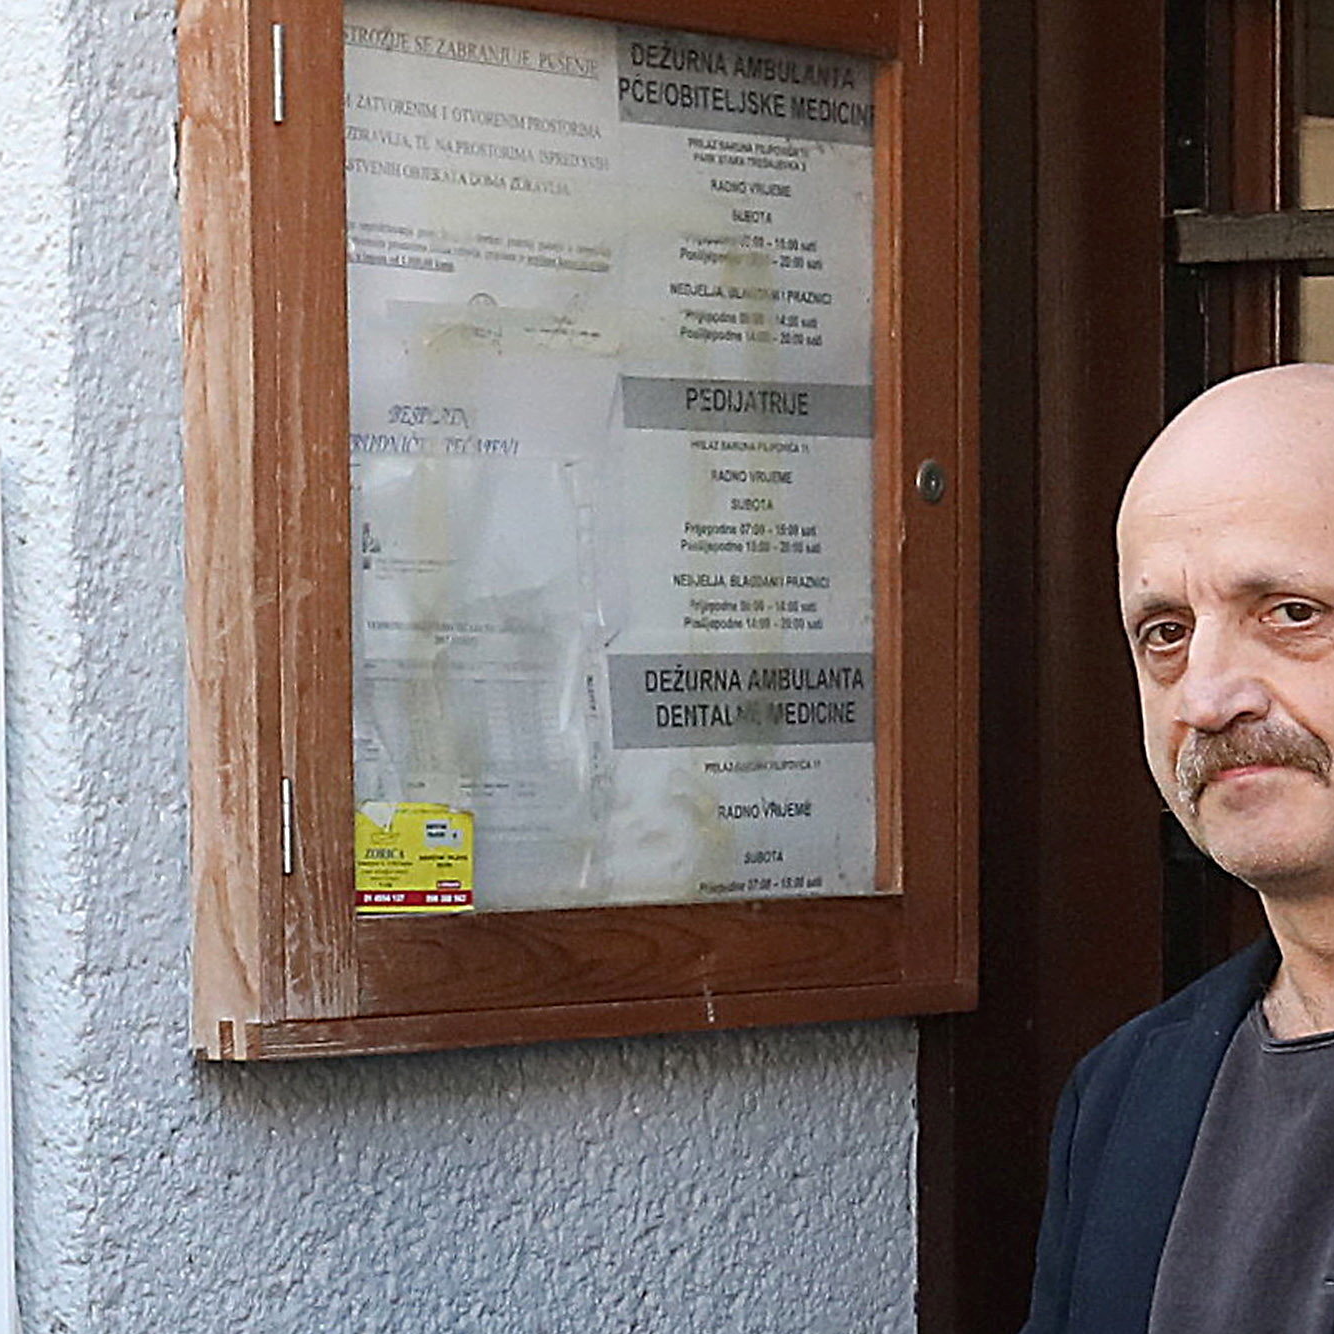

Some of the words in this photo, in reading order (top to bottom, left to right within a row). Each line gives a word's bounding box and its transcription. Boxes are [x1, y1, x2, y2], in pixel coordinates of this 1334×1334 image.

[415, 37, 432, 51] SE
[437, 38, 532, 67] ZABRANJUJE
[538, 51, 599, 75] PUŠENJE
[630, 42, 728, 77] DEŽURNA
[734, 54, 856, 90] AMBULANTA
[357, 95, 438, 121] ZATVORENIM
[711, 179, 747, 195] RADNO
[685, 387, 810, 416] PEDIJATRIJE
[711, 469, 747, 483] RADNO
[749, 470, 793, 485] VRIJEME
[730, 498, 774, 512] SUBOTA
[644, 664, 743, 693] DEŽURNA
[747, 667, 865, 693] AMBULANTA
[773, 701, 856, 726] MEDICINE
[718, 804, 760, 820] RADNO
[762, 800, 813, 819] VRIJEME
[743, 850, 784, 865] SUBOTA
